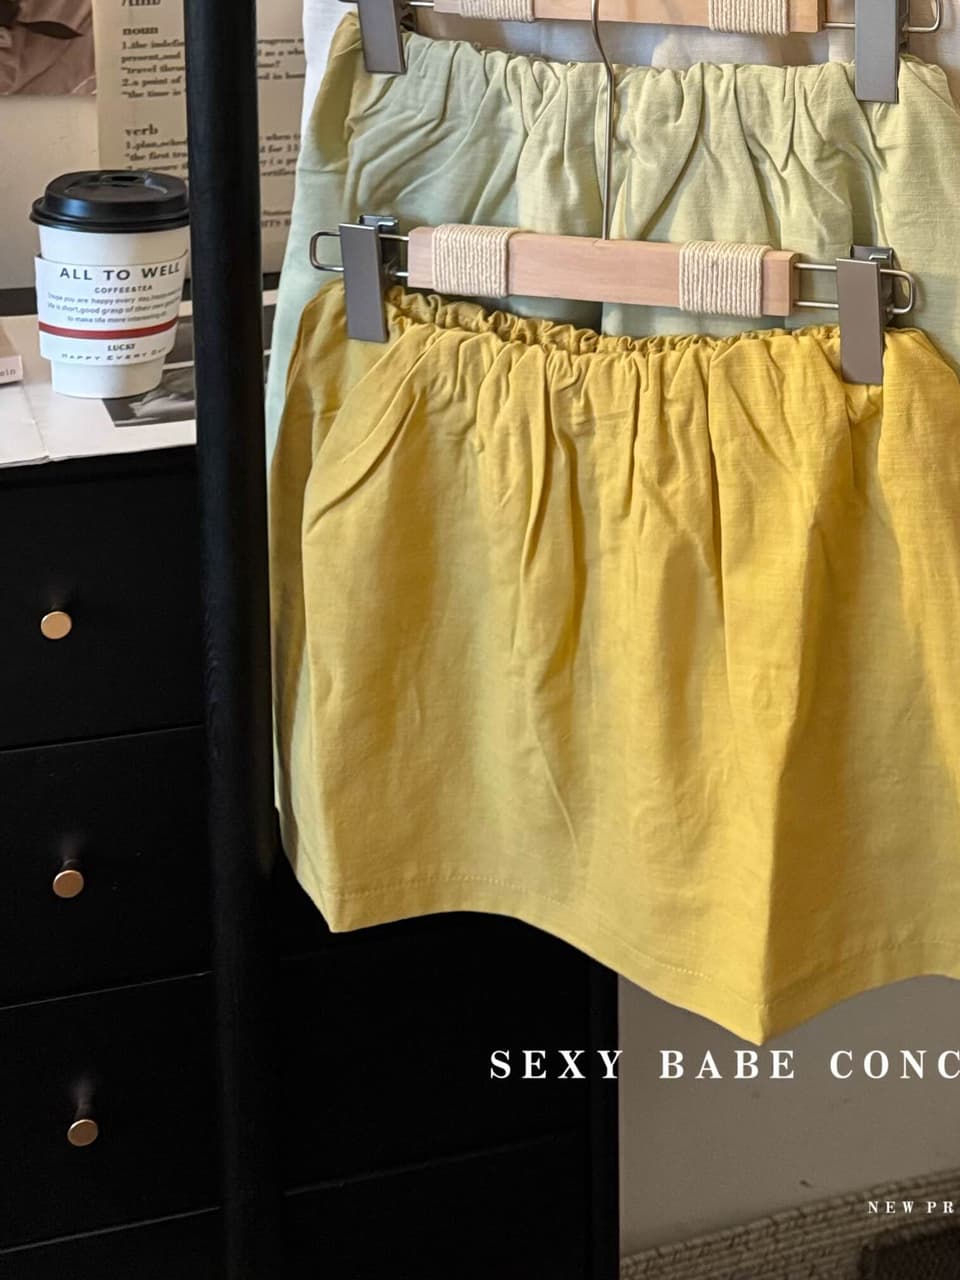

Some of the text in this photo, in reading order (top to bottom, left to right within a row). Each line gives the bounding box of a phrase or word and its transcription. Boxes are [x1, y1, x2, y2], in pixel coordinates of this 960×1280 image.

[123, 27, 158, 35] noun
[125, 124, 158, 136] verb
[60, 262, 181, 281] ALL TO WELL
